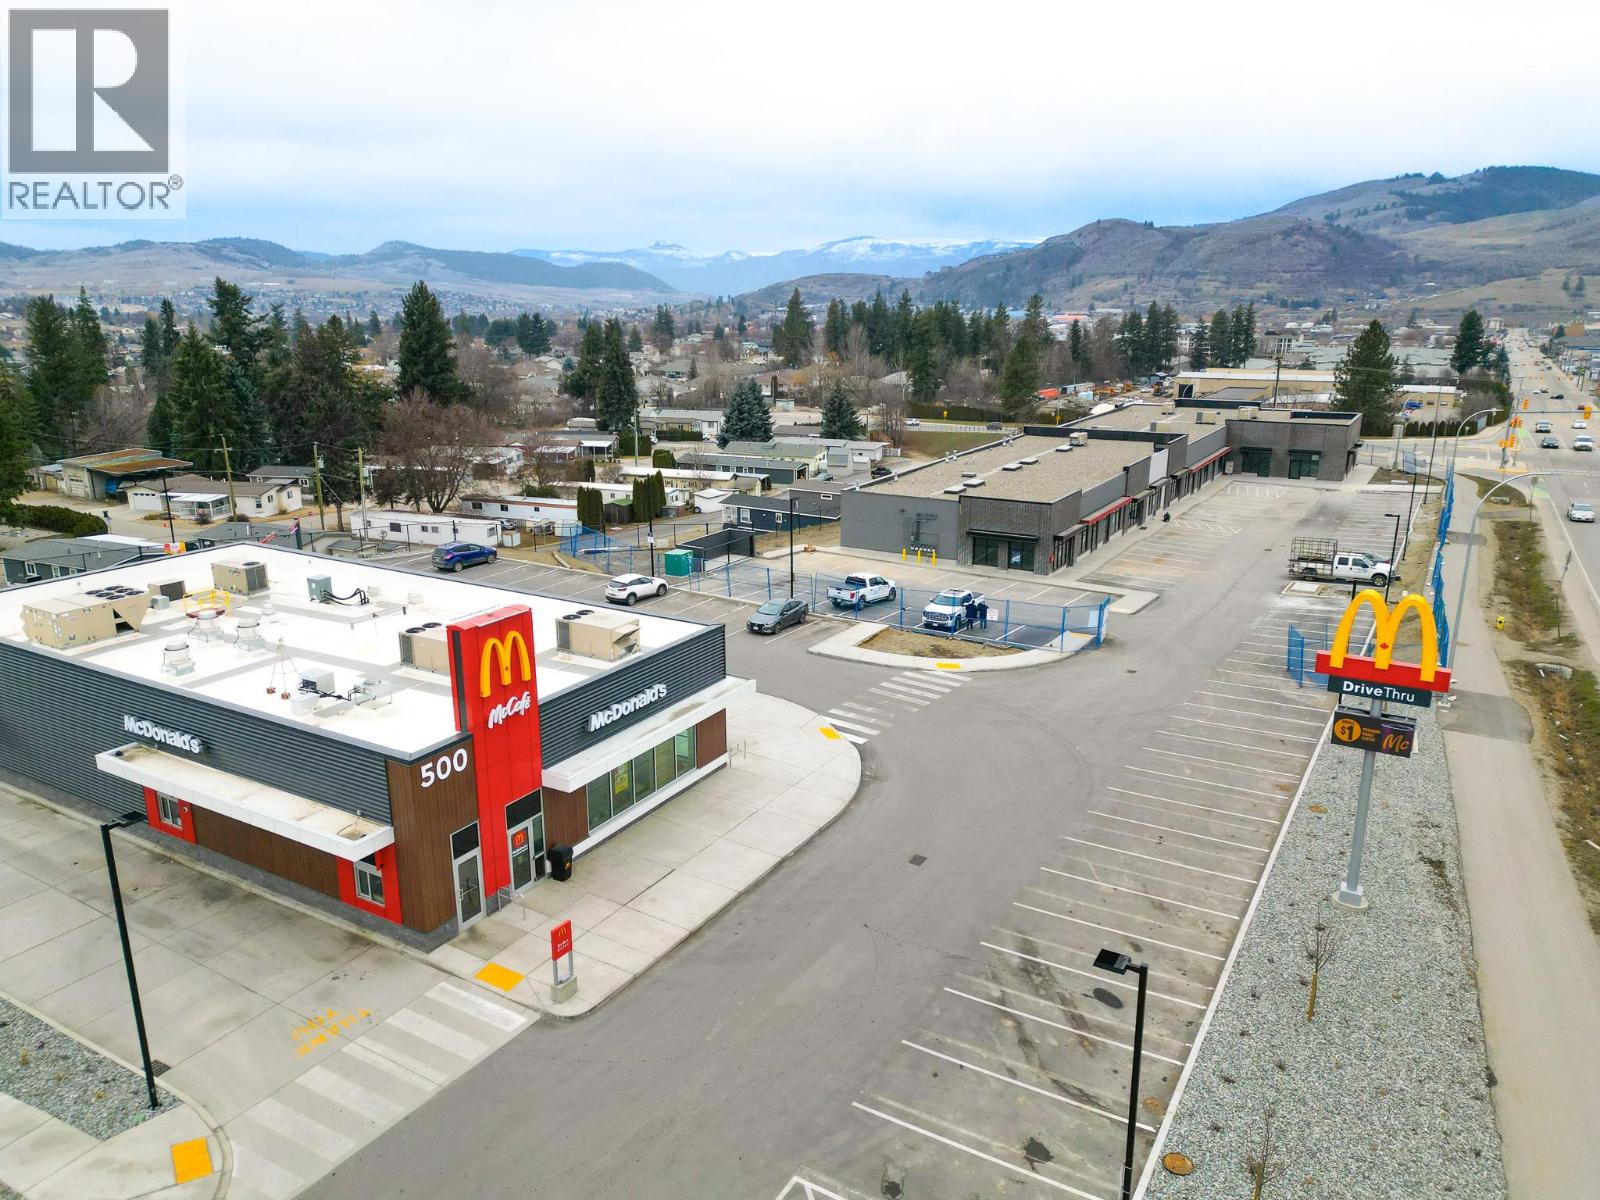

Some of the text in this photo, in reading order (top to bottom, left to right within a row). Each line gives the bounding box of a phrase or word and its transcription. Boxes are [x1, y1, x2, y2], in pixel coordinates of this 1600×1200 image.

[588, 684, 668, 732] McDonald's
[124, 714, 201, 754] McDonald's
[1382, 733, 1410, 752] Mc
[420, 748, 468, 788] 500
